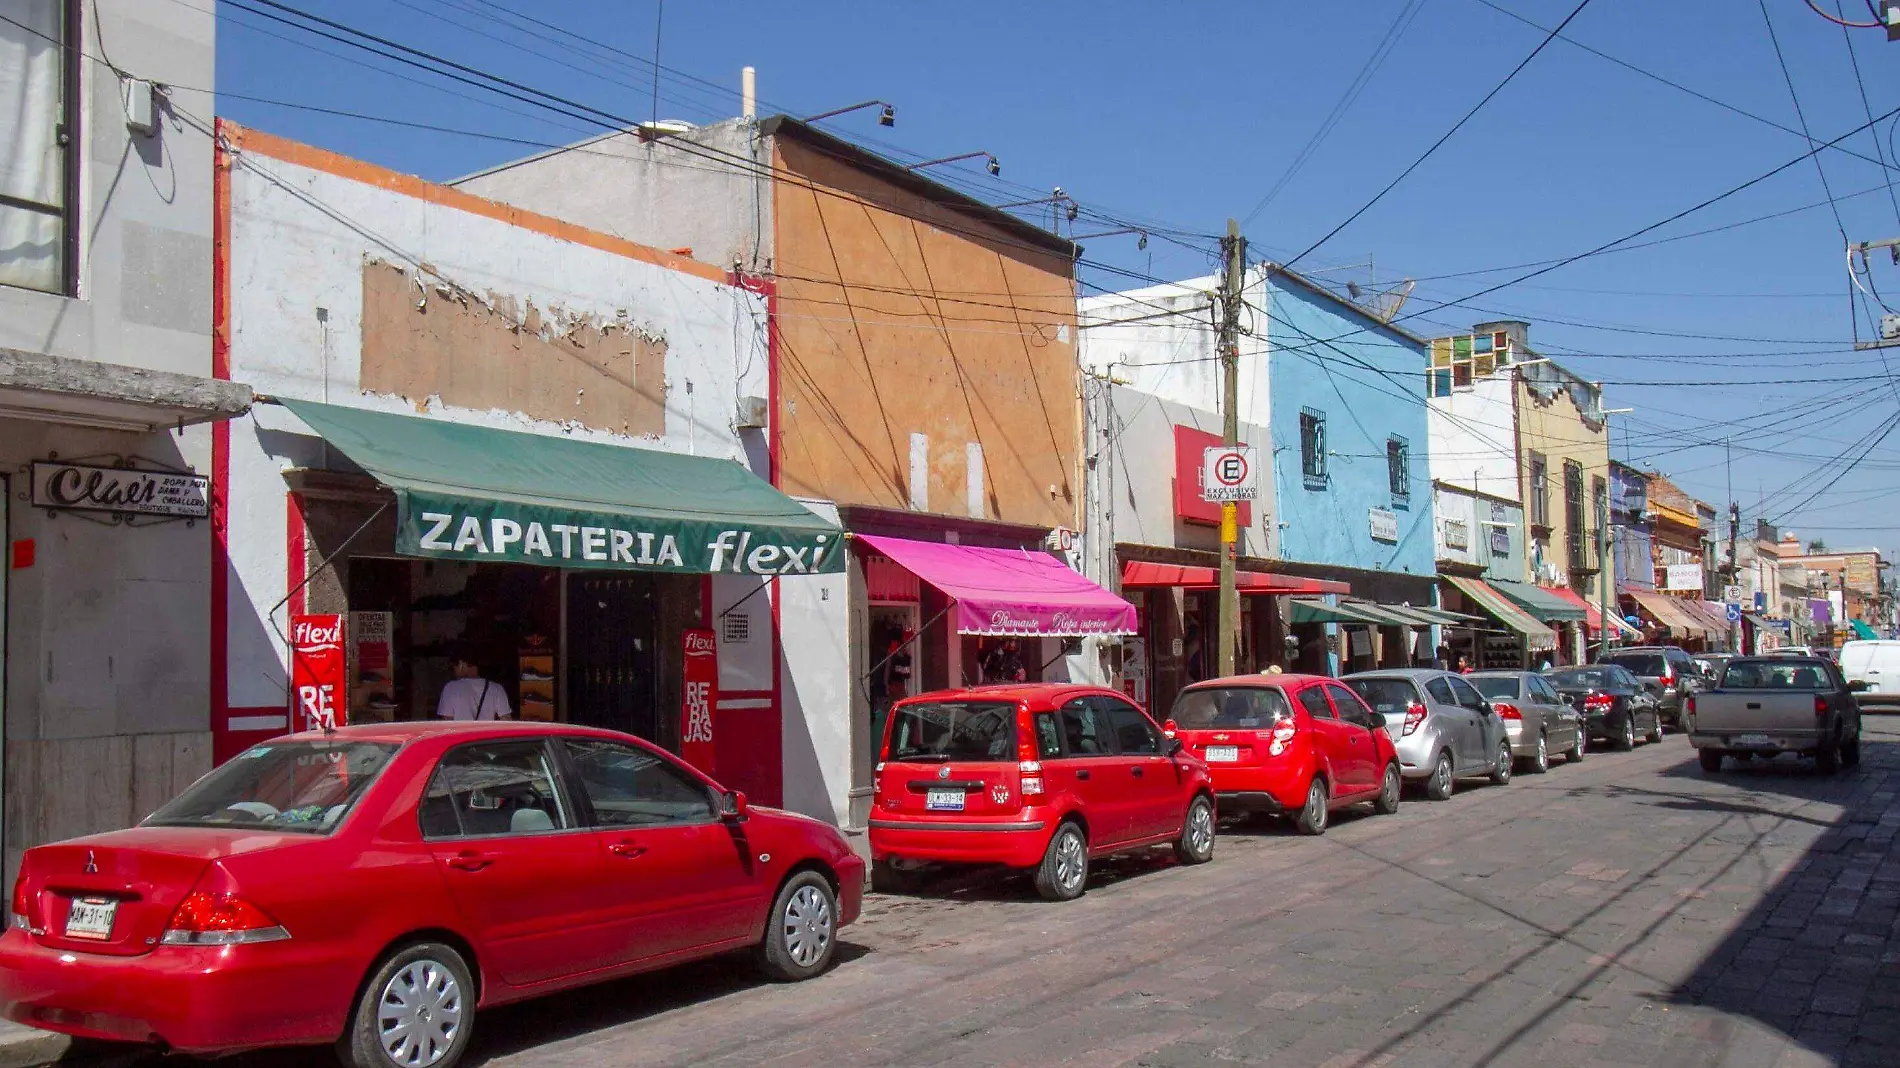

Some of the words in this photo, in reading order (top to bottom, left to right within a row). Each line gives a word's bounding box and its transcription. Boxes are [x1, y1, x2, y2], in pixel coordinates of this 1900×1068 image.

[163, 478, 186, 486] ROPA
[162, 496, 205, 507] CABALLERO
[419, 512, 684, 567] ZAPATERIA
[707, 530, 827, 574] flexi
[991, 609, 1039, 628] Diamante
[1052, 612, 1077, 633] Ropa
[295, 621, 341, 644] flexi
[686, 632, 715, 650] flexi
